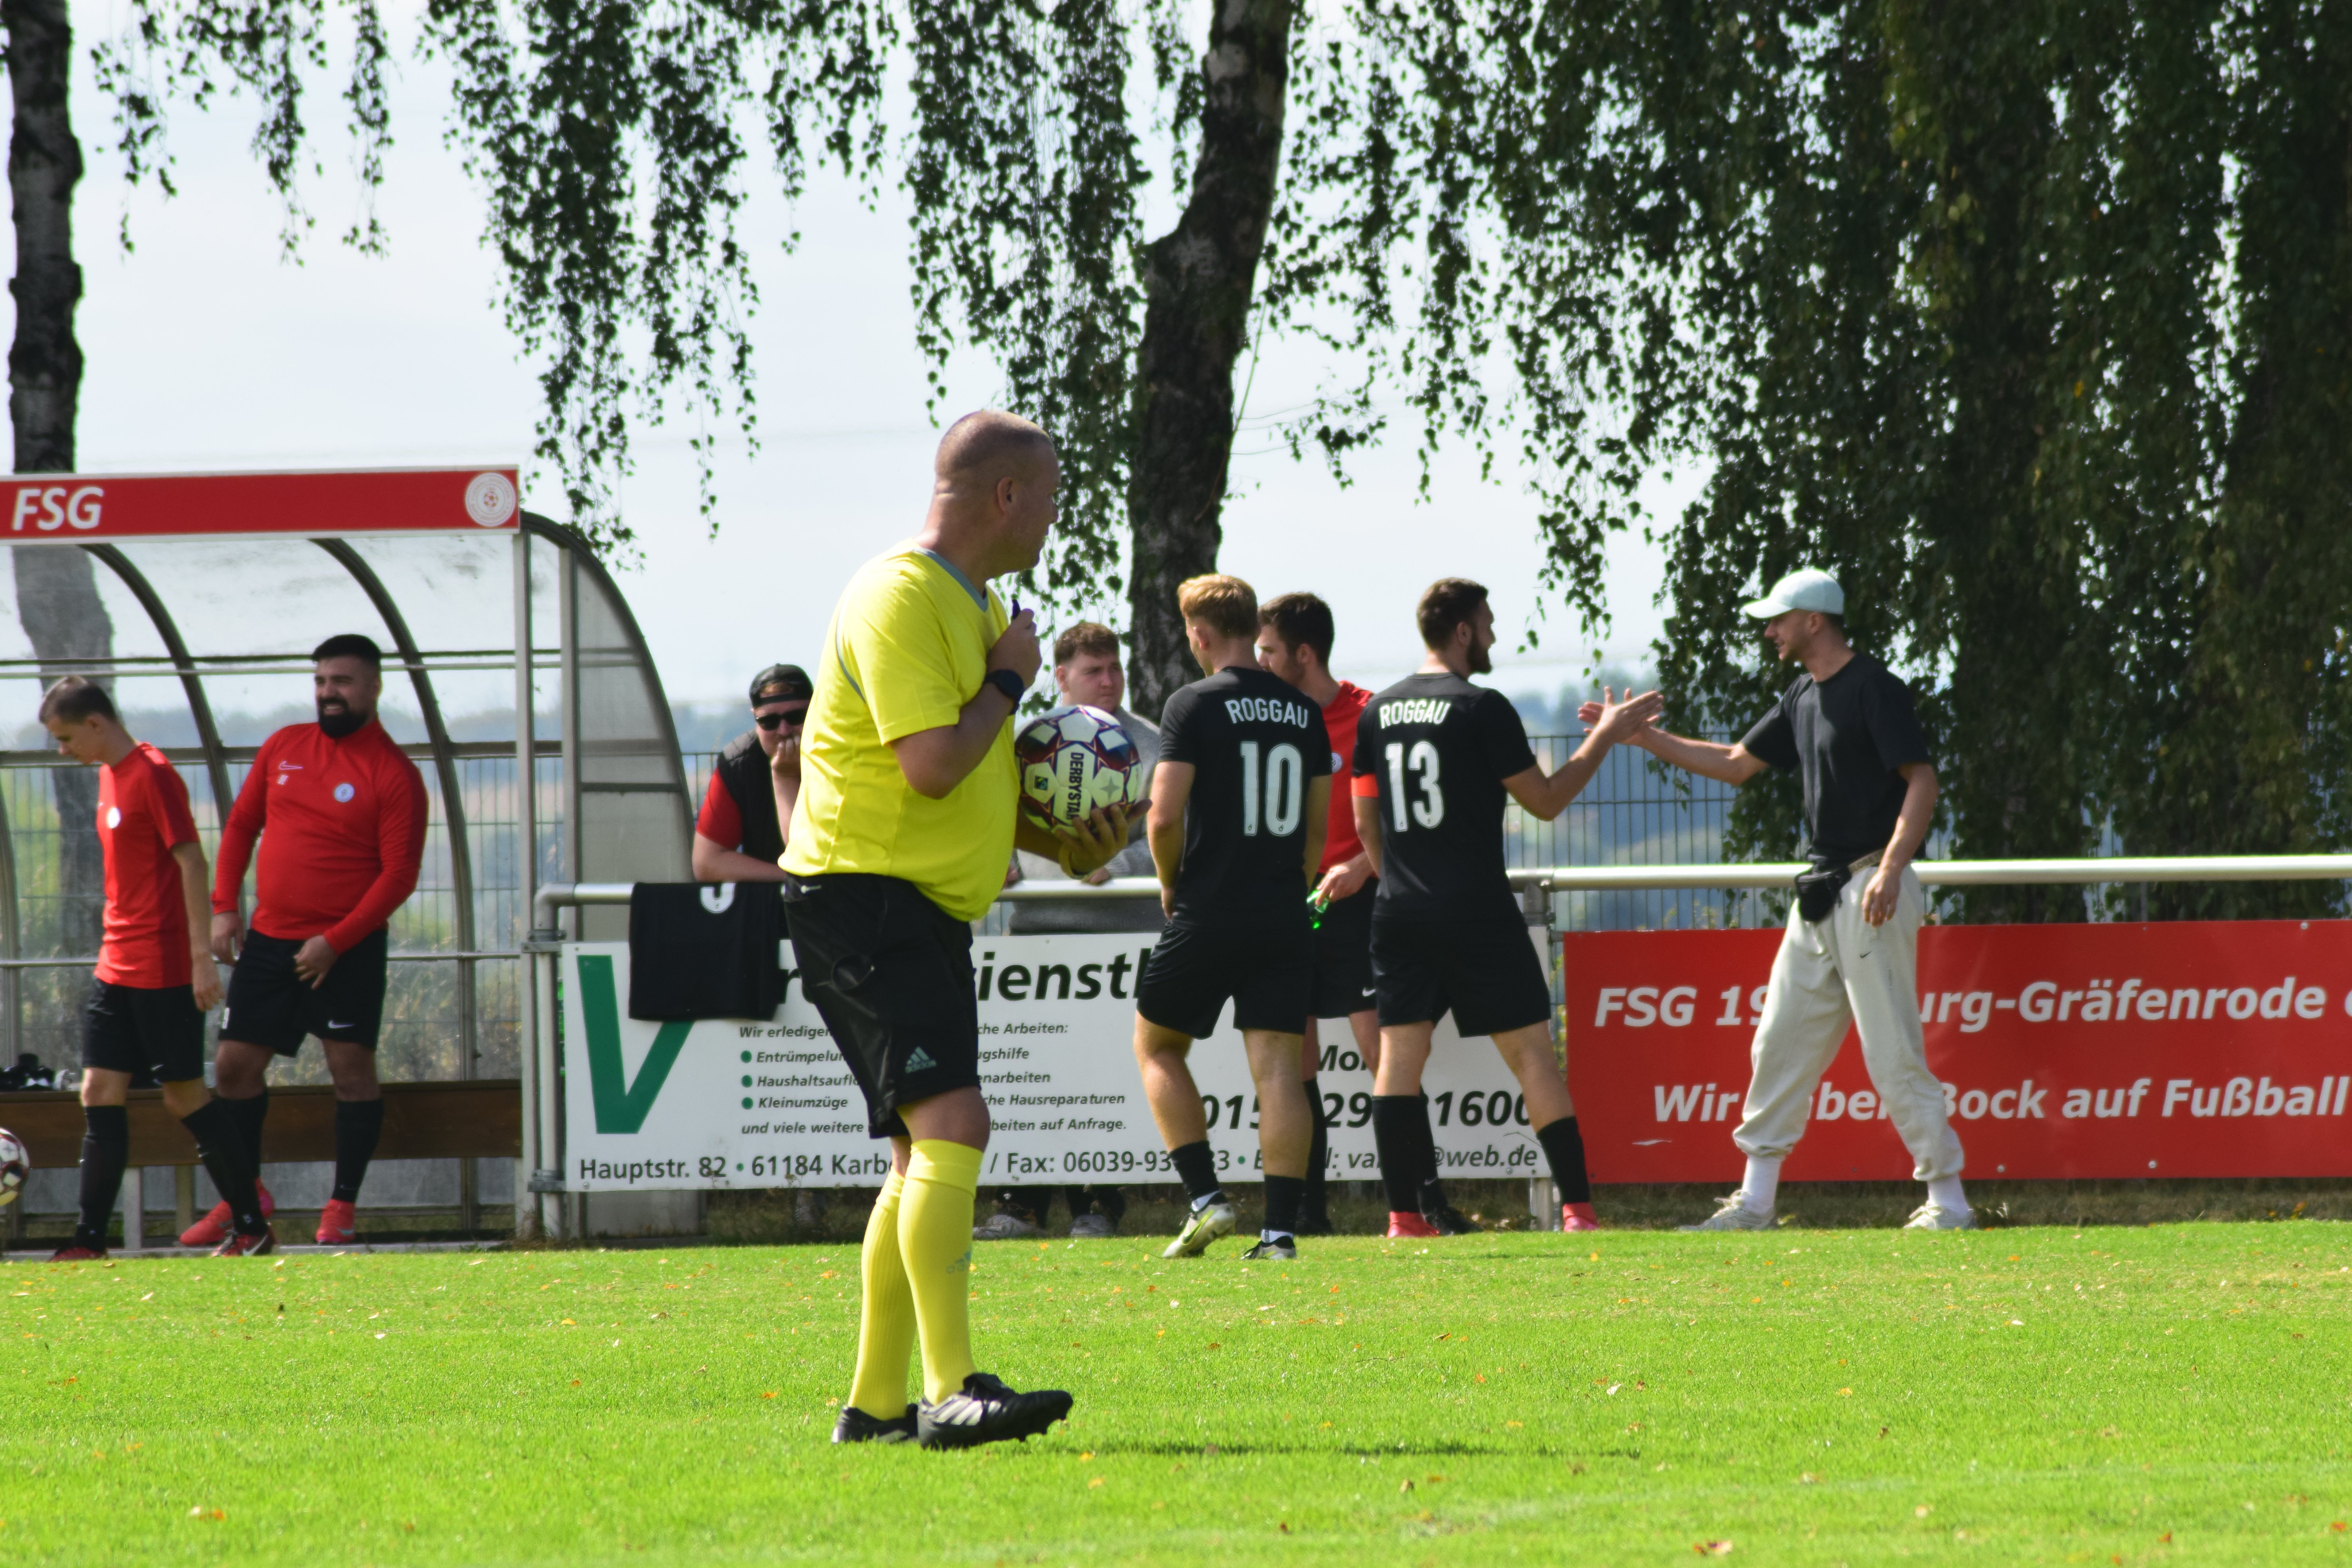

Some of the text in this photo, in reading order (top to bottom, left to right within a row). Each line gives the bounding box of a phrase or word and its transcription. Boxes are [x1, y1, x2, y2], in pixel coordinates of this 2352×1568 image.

[12, 486, 104, 531] FSG
[1225, 697, 1308, 729] ROGGAU
[1379, 698, 1452, 729] ROGGAU
[1240, 741, 1302, 837] 10
[1385, 741, 1444, 832] 13
[1595, 985, 1697, 1027] FSG
[740, 1026, 763, 1038] Wir
[1003, 1022, 1068, 1034] Arbeiten:
[759, 1096, 848, 1111] Kleinumzüge
[1009, 1094, 1125, 1107] Hausreparaturen
[1655, 1083, 1739, 1122] Wir
[2062, 1078, 2152, 1119] auf
[2162, 1076, 2350, 1117] Fußball
[741, 1122, 769, 1134] und
[774, 1122, 806, 1133] viele
[811, 1122, 864, 1133] weitere
[1040, 1118, 1065, 1130] auf
[1067, 1118, 1126, 1132] Anfrage.
[580, 1159, 690, 1184] Hauptstr.
[699, 1156, 727, 1177] 82
[752, 1155, 823, 1176] 61184
[832, 1153, 892, 1175] Karb
[1007, 1152, 1054, 1173] Fax:
